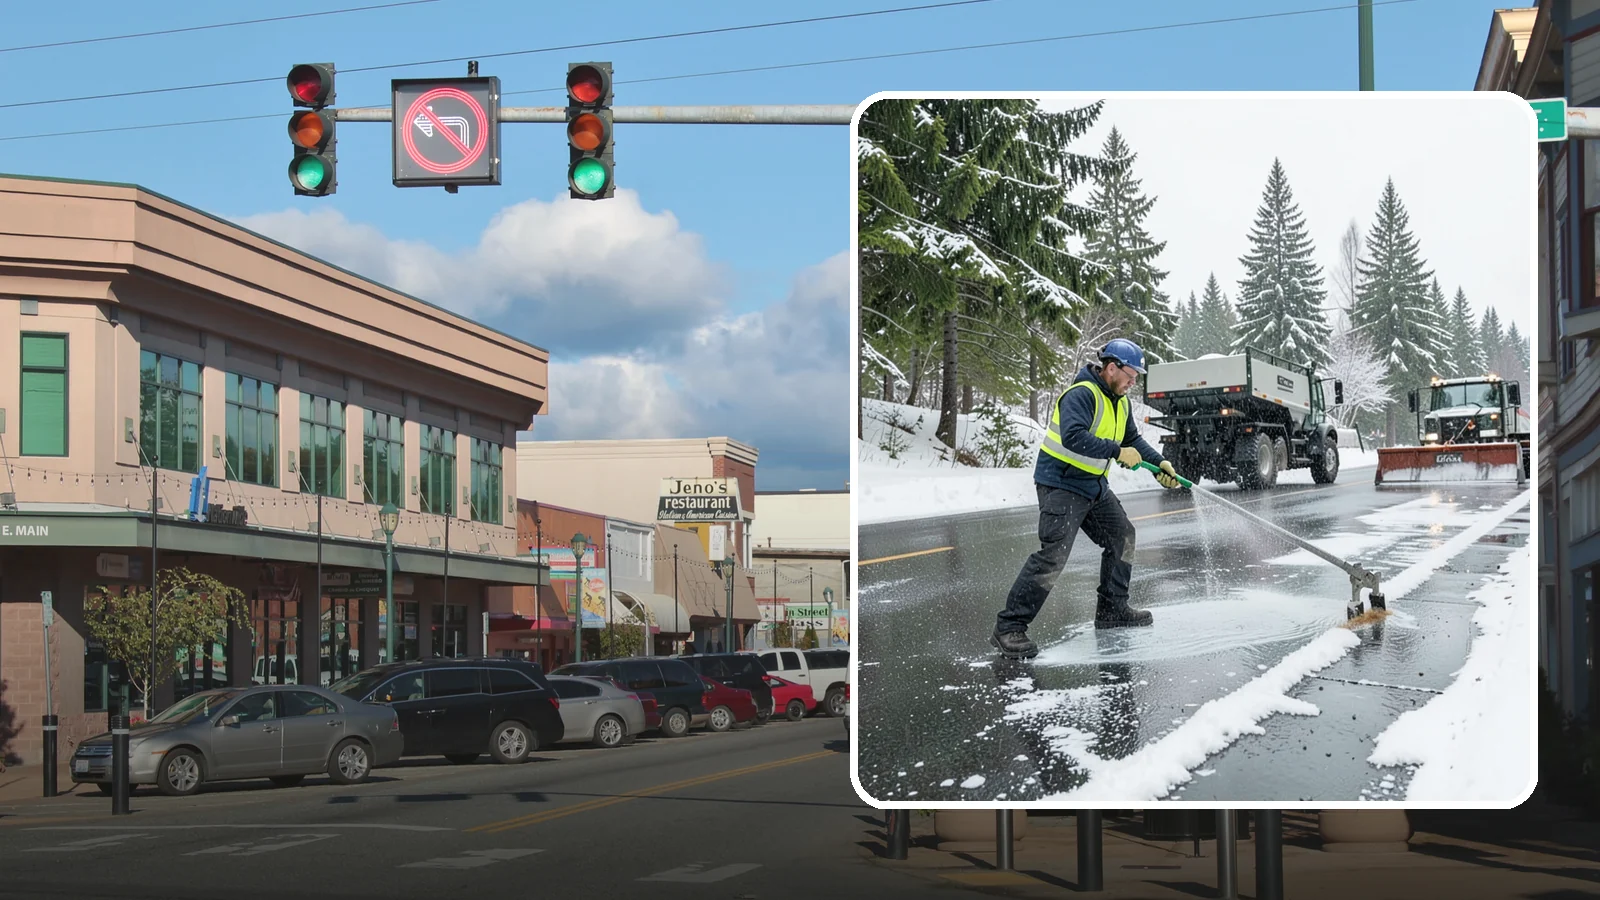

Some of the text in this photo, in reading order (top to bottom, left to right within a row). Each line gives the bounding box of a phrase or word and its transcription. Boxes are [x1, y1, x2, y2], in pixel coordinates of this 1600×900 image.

[669, 480, 728, 495] Jeno's
[665, 496, 731, 509] restaurant
[658, 509, 681, 519] Italian
[686, 509, 715, 519] American
[715, 509, 738, 519] Cuisine
[2, 525, 49, 536] E. MAIN
[786, 607, 828, 617] in Street
[790, 619, 823, 627] lass
